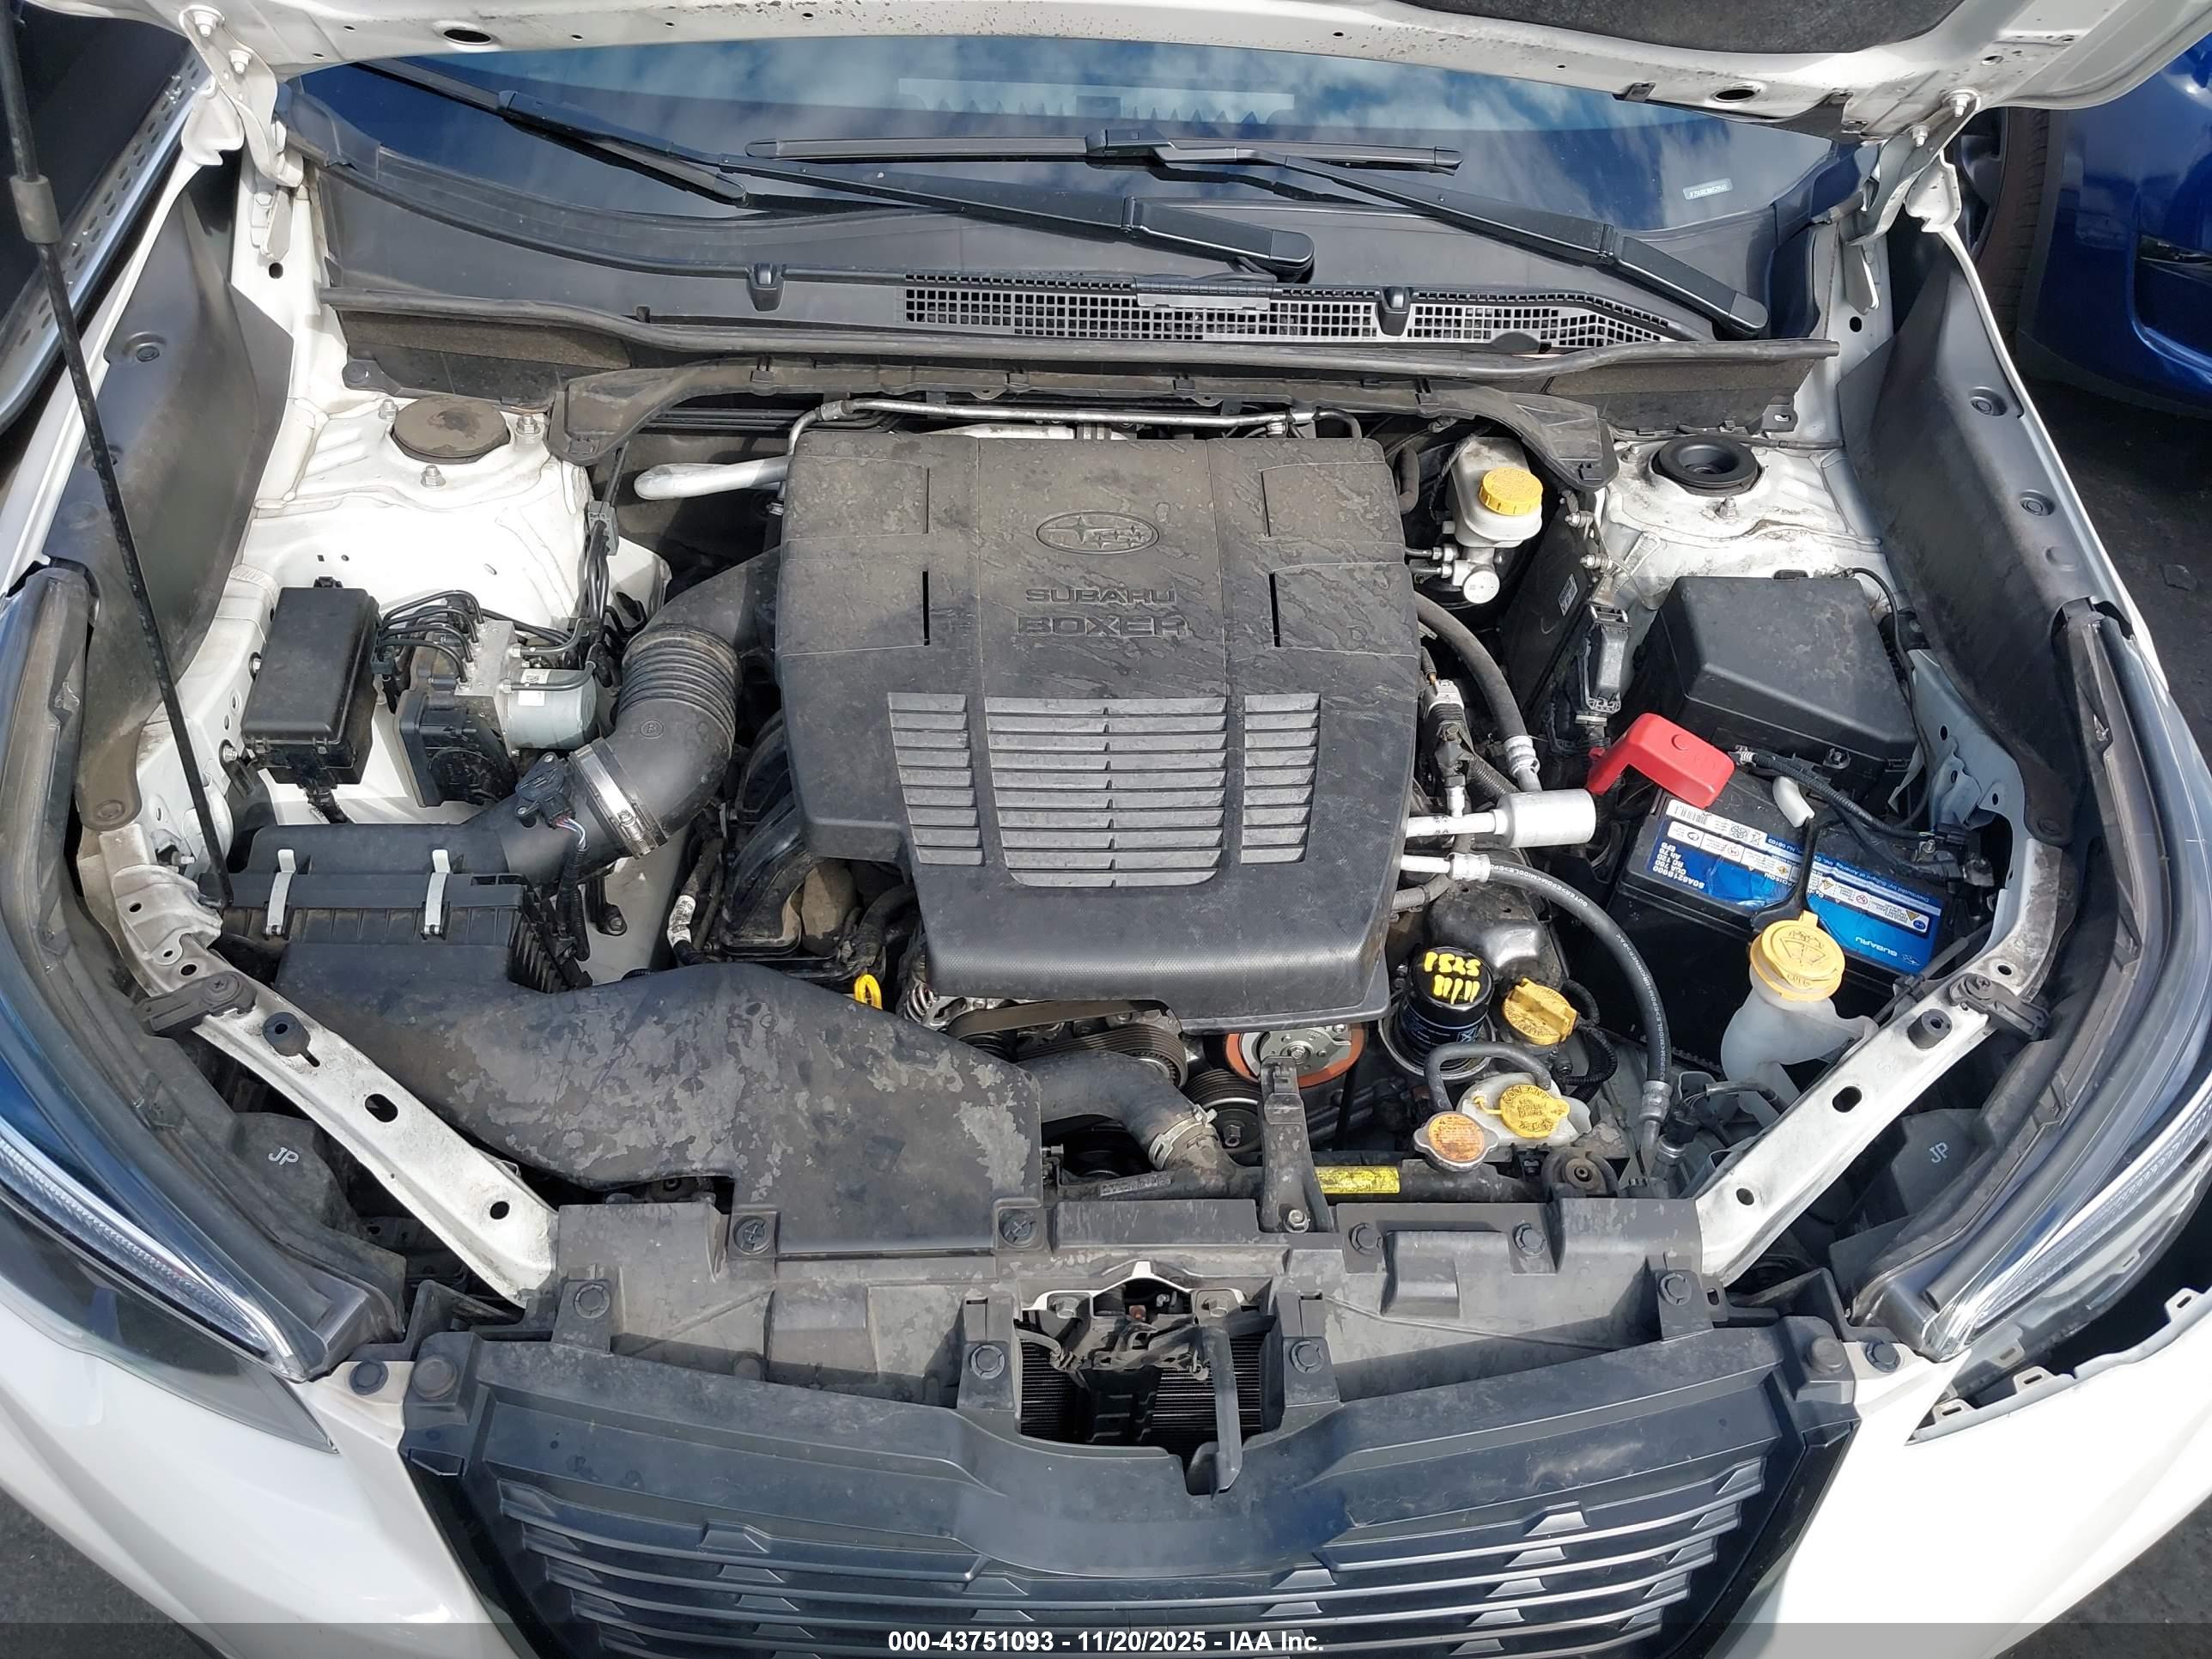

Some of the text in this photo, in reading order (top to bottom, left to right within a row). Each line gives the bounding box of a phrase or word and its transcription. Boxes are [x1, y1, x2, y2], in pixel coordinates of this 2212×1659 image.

[1024, 587, 1176, 605] SUBARU
[1018, 615, 1188, 636] BOXER
[1855, 936, 1898, 957] SUBARU
[1503, 1085, 1551, 1104] COOLANT
[267, 1146, 299, 1165] JP
[1929, 1141, 1950, 1164] JP
